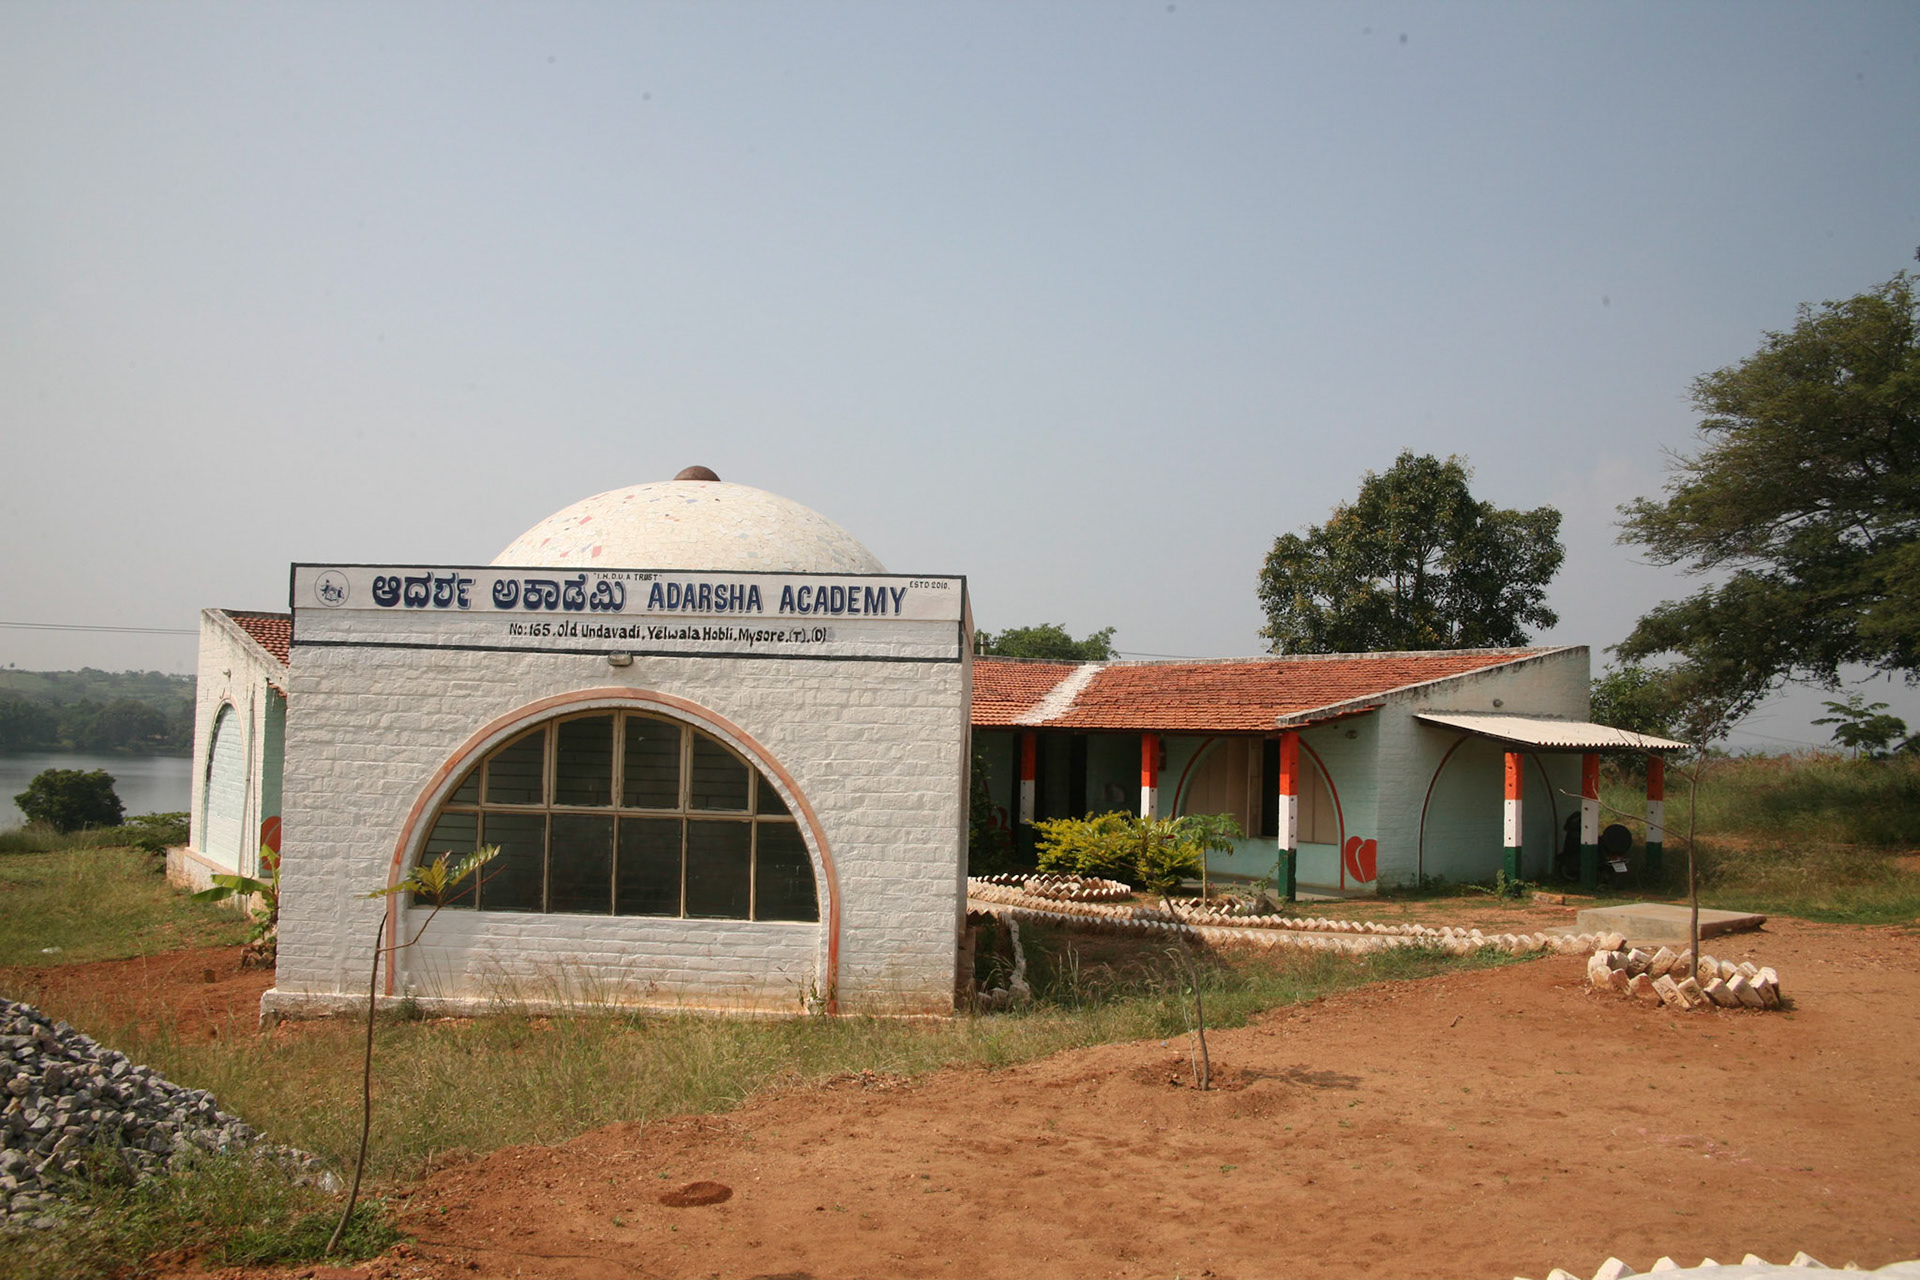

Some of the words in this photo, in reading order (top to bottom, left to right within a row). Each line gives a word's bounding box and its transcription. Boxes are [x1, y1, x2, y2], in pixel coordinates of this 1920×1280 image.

[372, 571, 475, 609] ಆದರ್ಶ
[492, 573, 626, 613] ಅಕಾಡೆಮಿ
[647, 582, 762, 612] ADARSHA
[779, 585, 908, 616] ACADEMY
